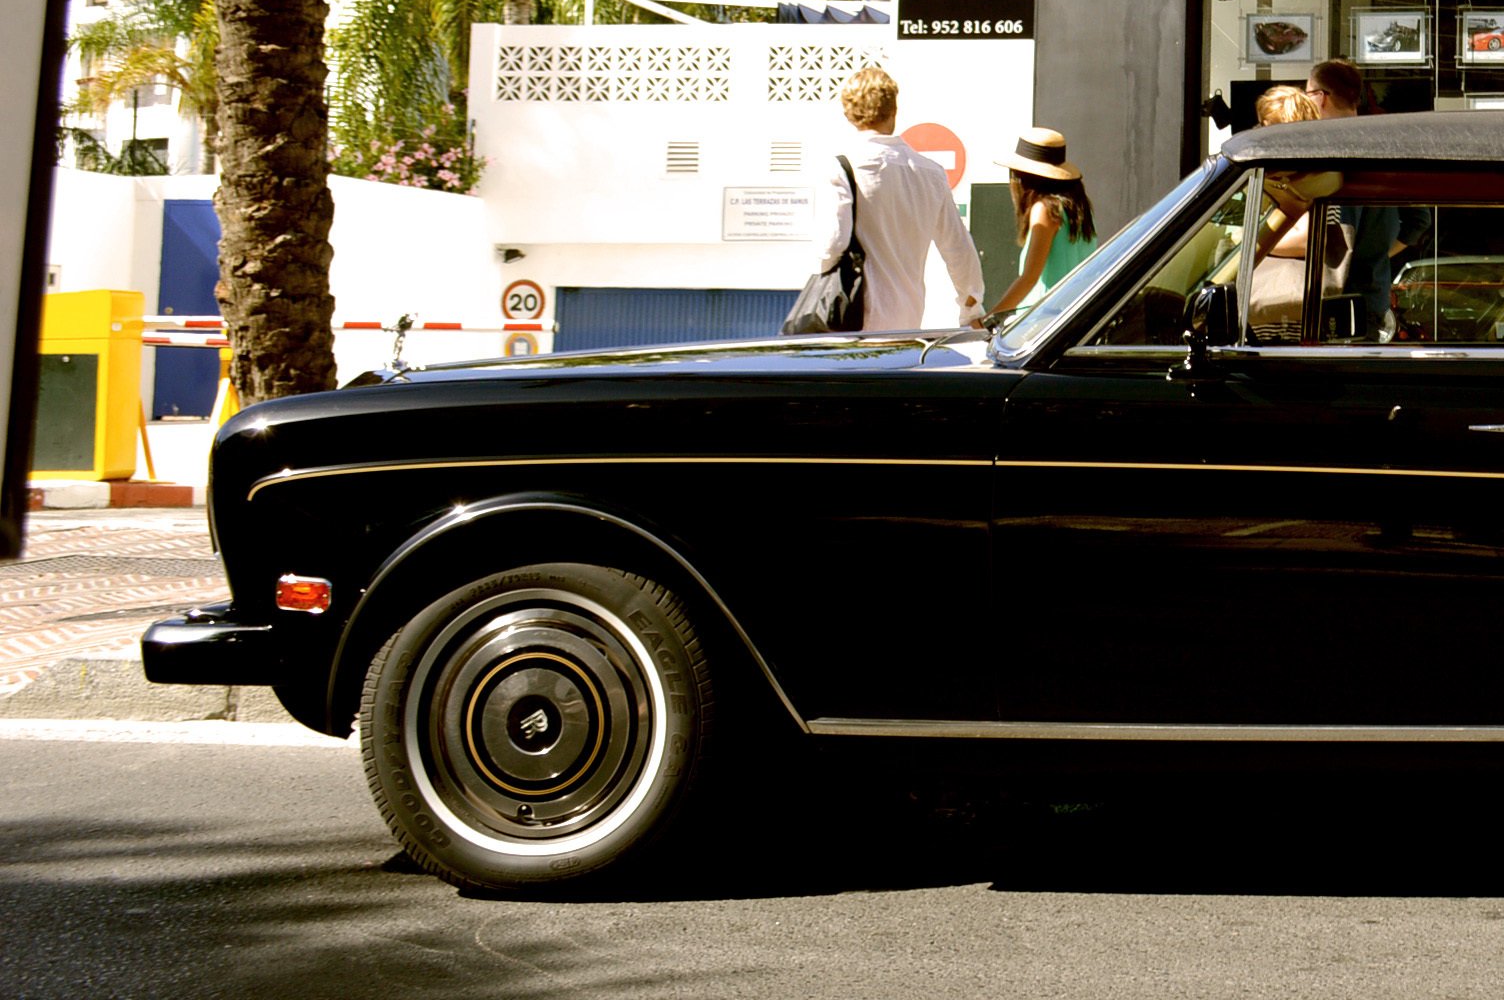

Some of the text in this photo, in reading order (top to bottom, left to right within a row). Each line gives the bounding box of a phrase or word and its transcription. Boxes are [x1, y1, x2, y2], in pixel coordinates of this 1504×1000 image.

[900, 19, 1023, 34] Tel: 952 816 606
[510, 293, 537, 311] 20
[626, 608, 688, 715] EAGLE
